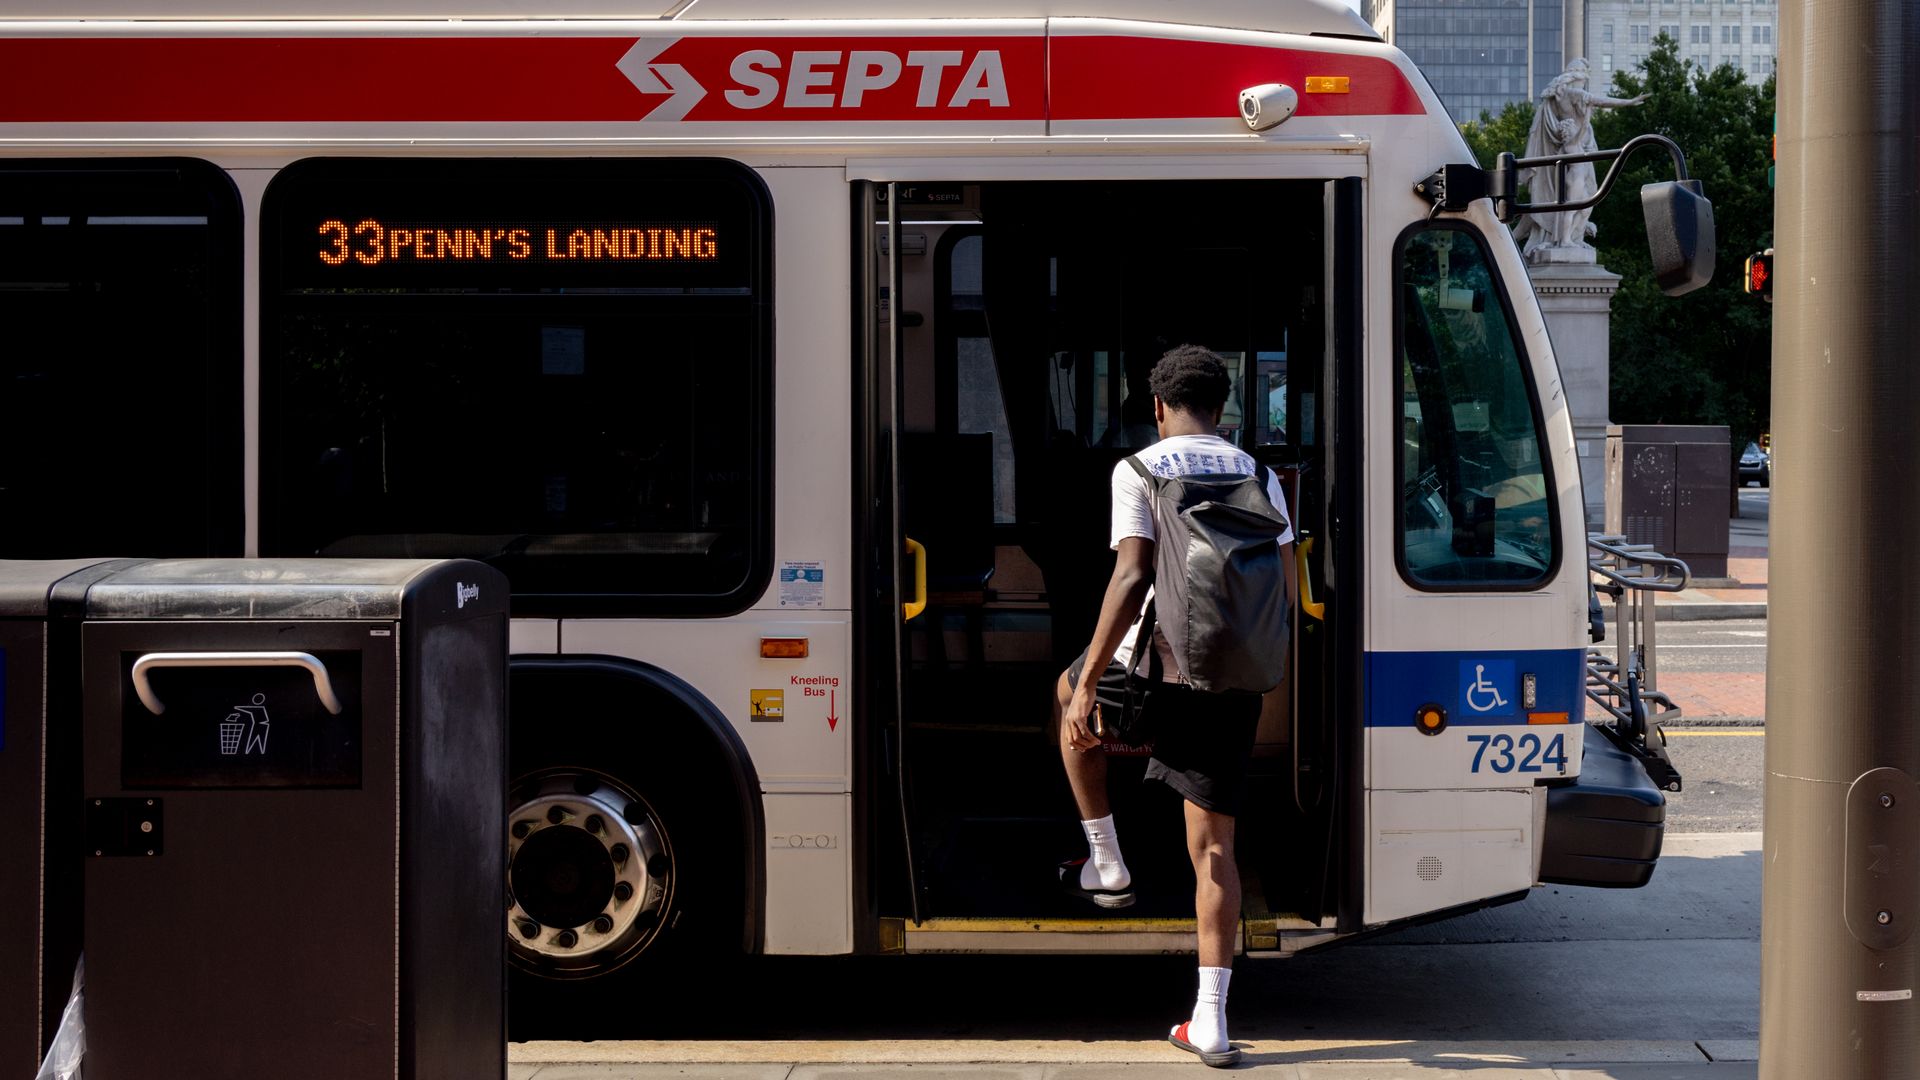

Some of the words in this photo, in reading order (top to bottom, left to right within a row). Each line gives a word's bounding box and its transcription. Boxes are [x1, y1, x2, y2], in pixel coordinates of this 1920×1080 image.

[724, 49, 1010, 110] SEPTA
[319, 220, 384, 265] 33
[390, 229, 530, 258] PENN'S
[547, 229, 716, 258] LANDING
[456, 582, 479, 608] Bigbelly
[791, 675, 839, 687] Kneeling
[804, 687, 826, 696] Bus
[1467, 733, 1568, 774] 7324
